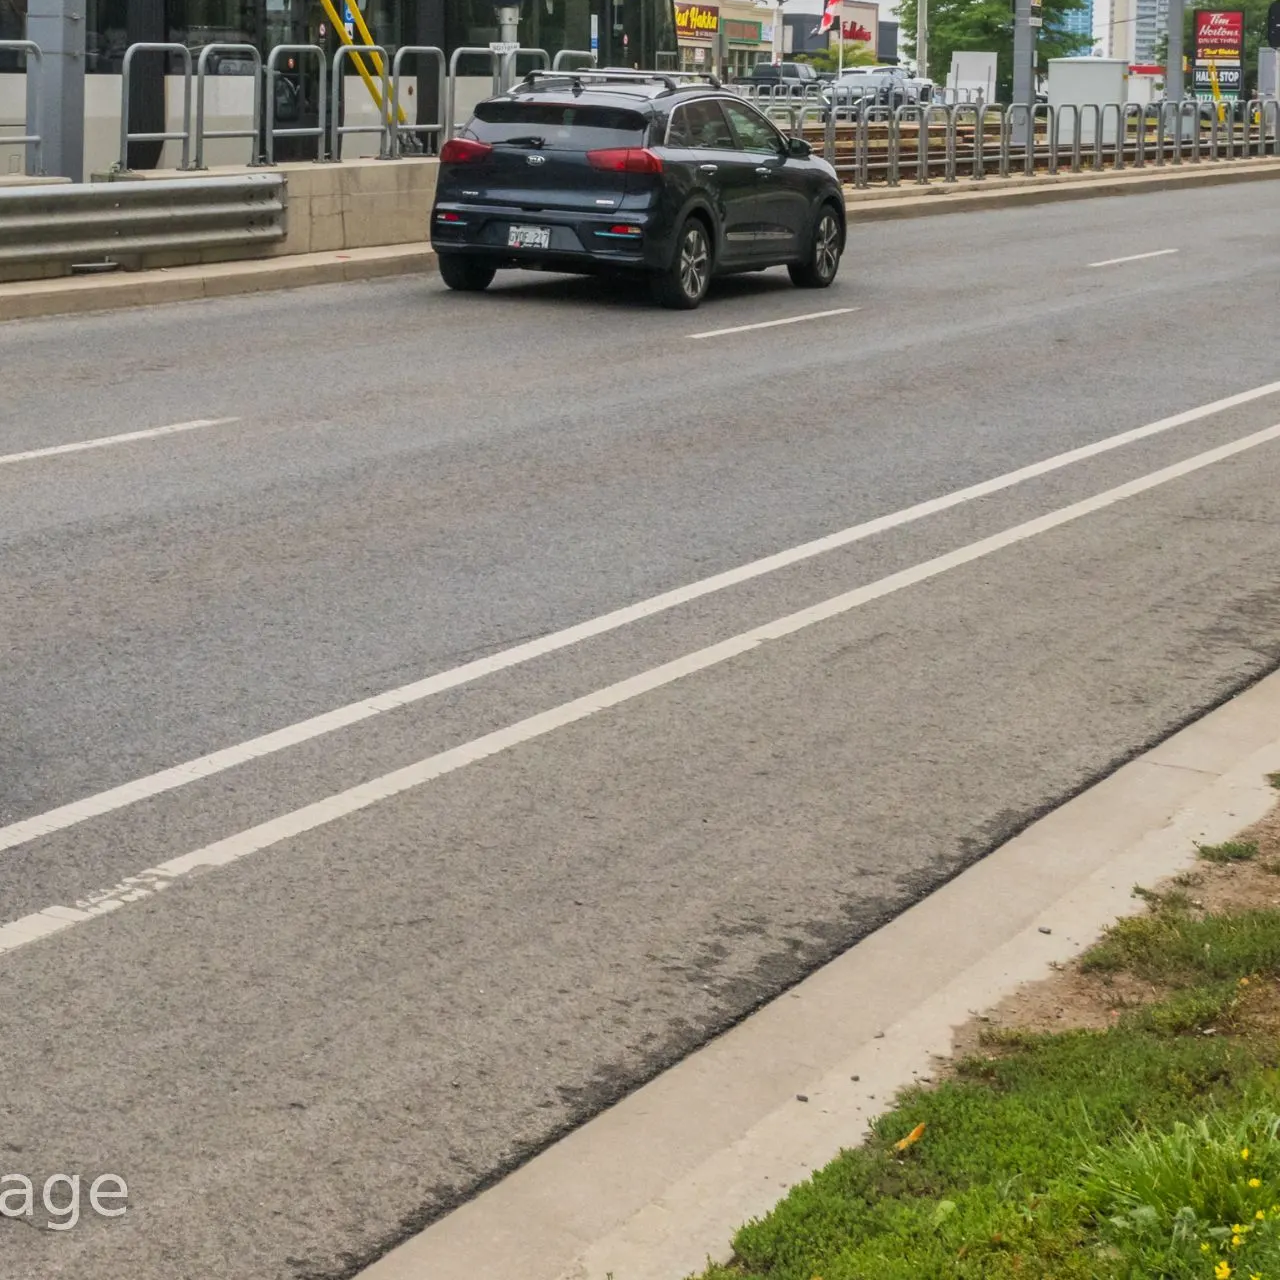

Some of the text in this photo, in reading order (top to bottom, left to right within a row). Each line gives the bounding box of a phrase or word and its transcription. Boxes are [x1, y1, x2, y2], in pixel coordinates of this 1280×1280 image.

[690, 6, 718, 29] Hakka
[1210, 13, 1230, 25] Tim
[1199, 24, 1240, 36] Hortons
[1219, 72, 1239, 81] STOP
